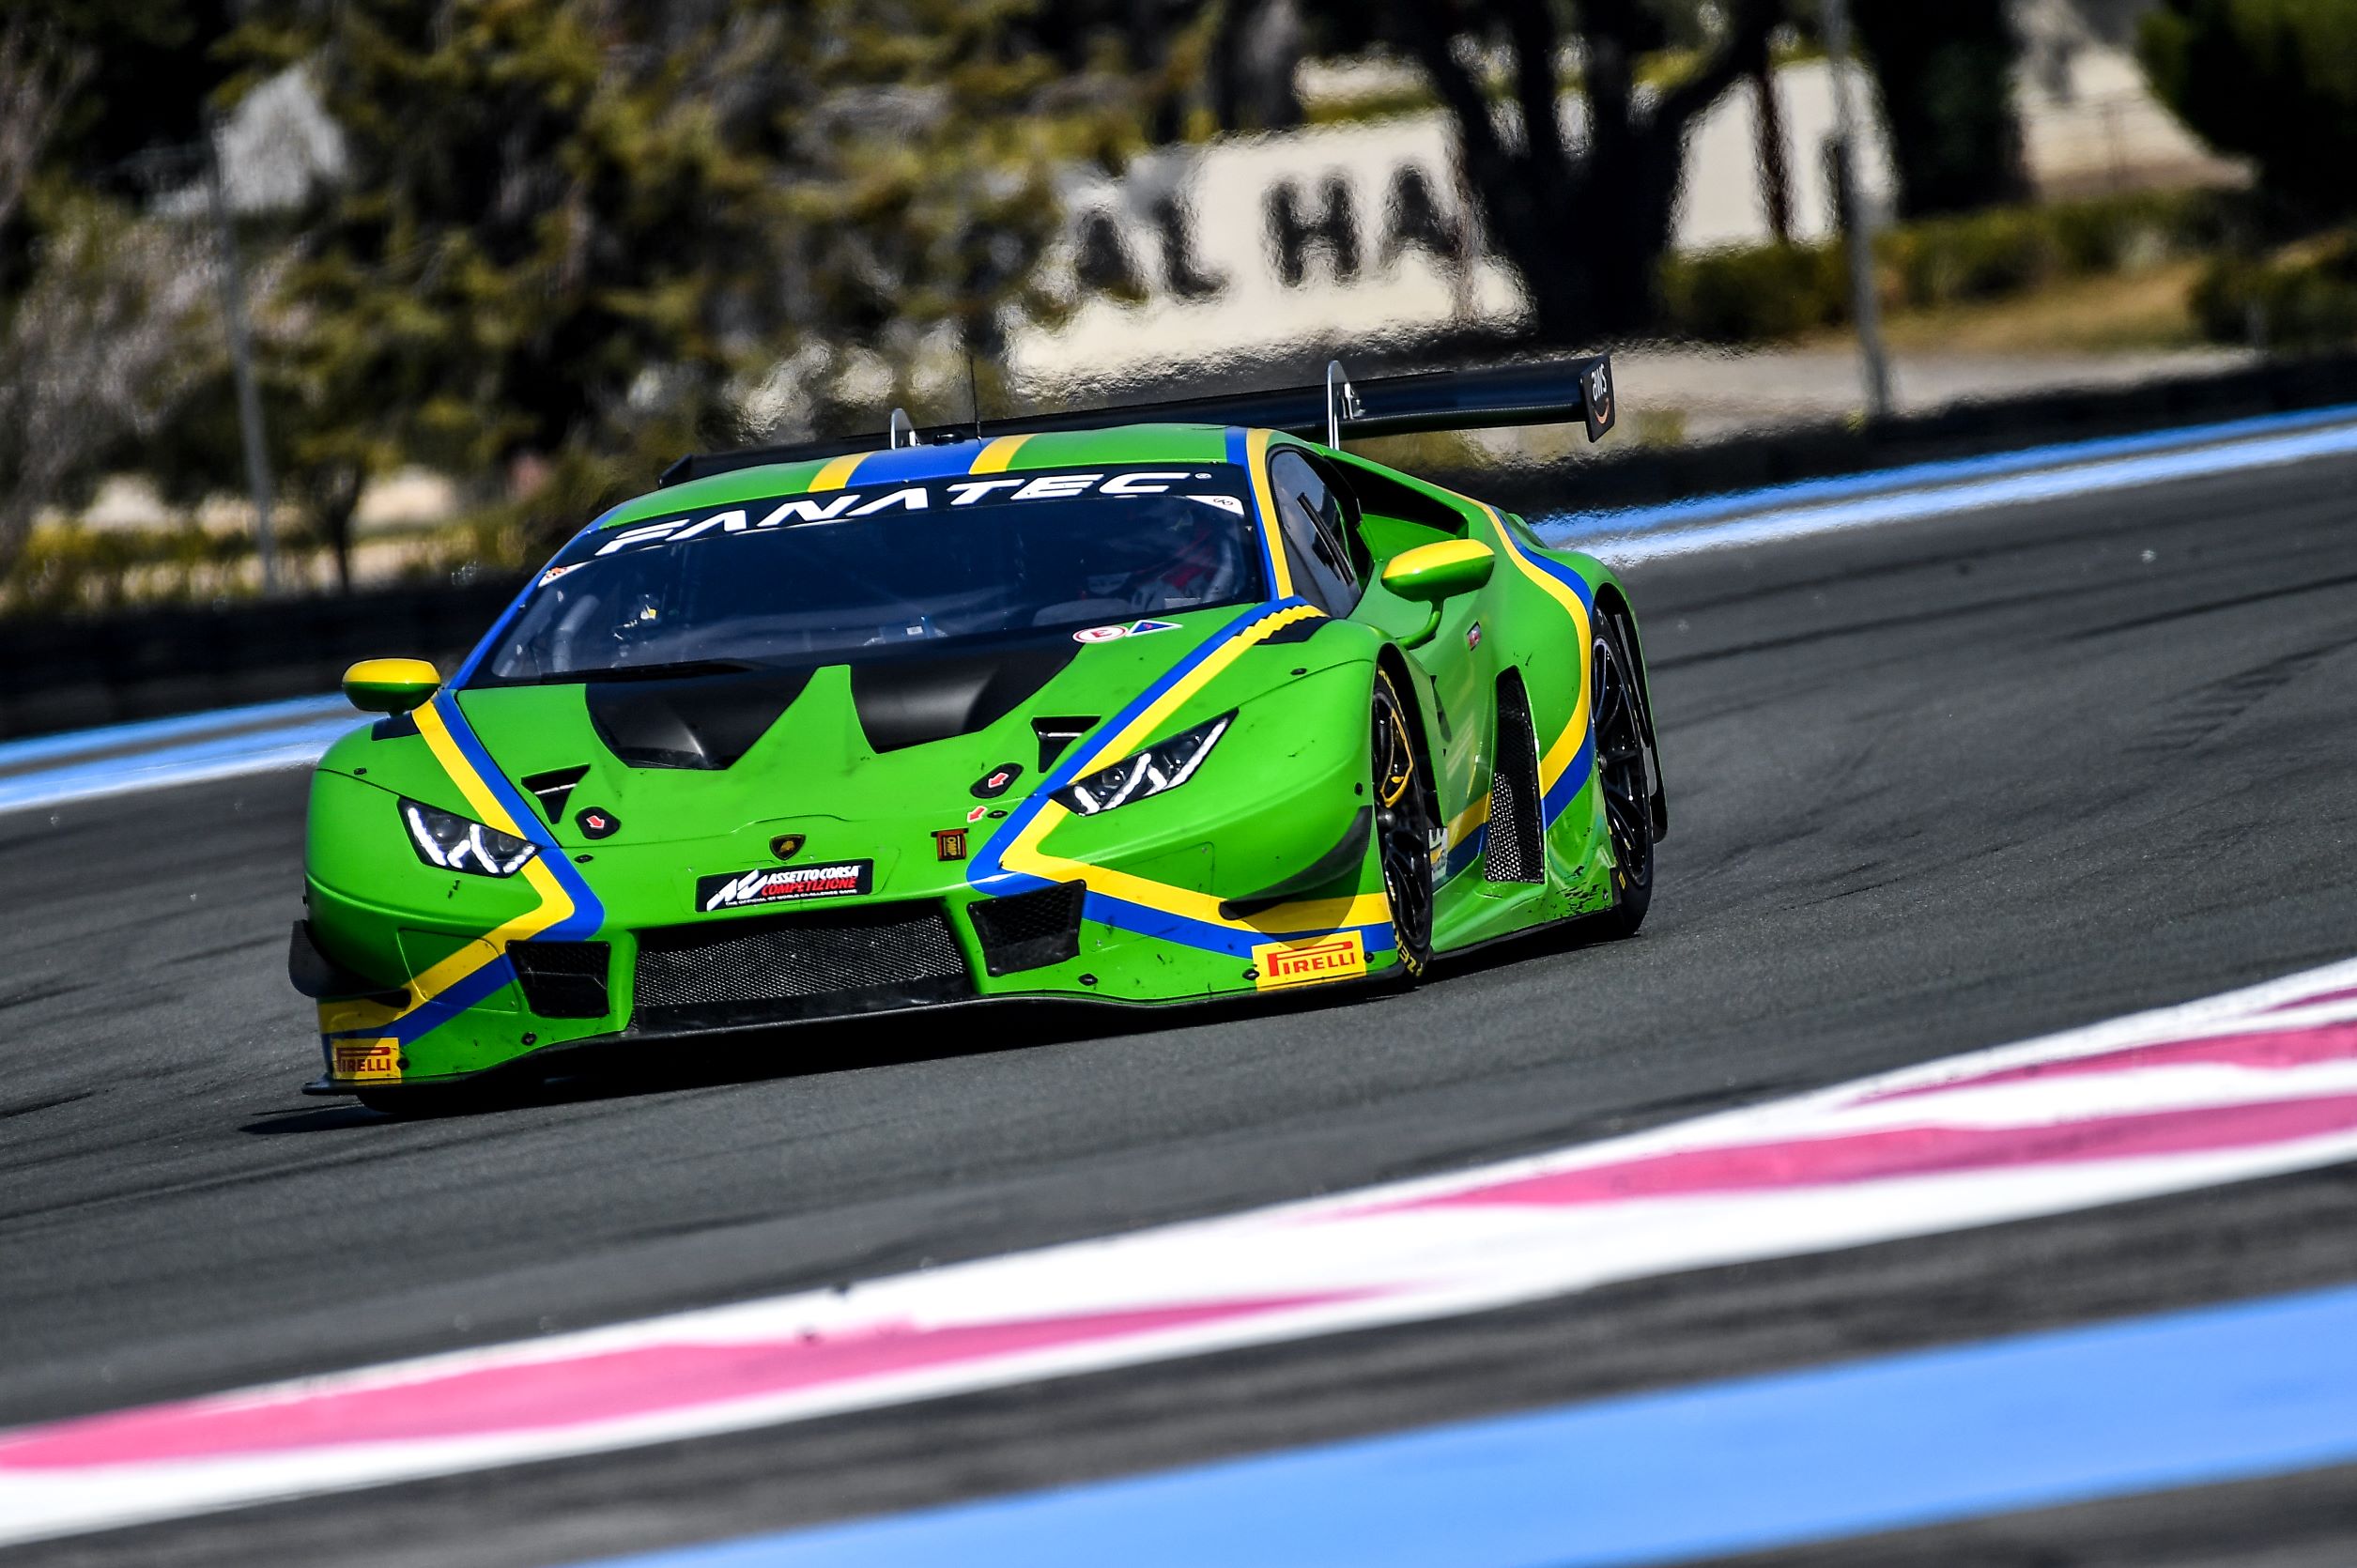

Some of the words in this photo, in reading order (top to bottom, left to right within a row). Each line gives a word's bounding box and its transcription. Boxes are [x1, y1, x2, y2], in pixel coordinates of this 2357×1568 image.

[1591, 362, 1608, 401] aws
[595, 472, 1192, 556] FANATEC
[761, 876, 857, 897] COMPETIZIONE
[766, 869, 820, 885] ASSETTO
[819, 865, 860, 880] CORSA
[1267, 941, 1354, 977] PIRELLI
[336, 1047, 392, 1072] PIRELLI
